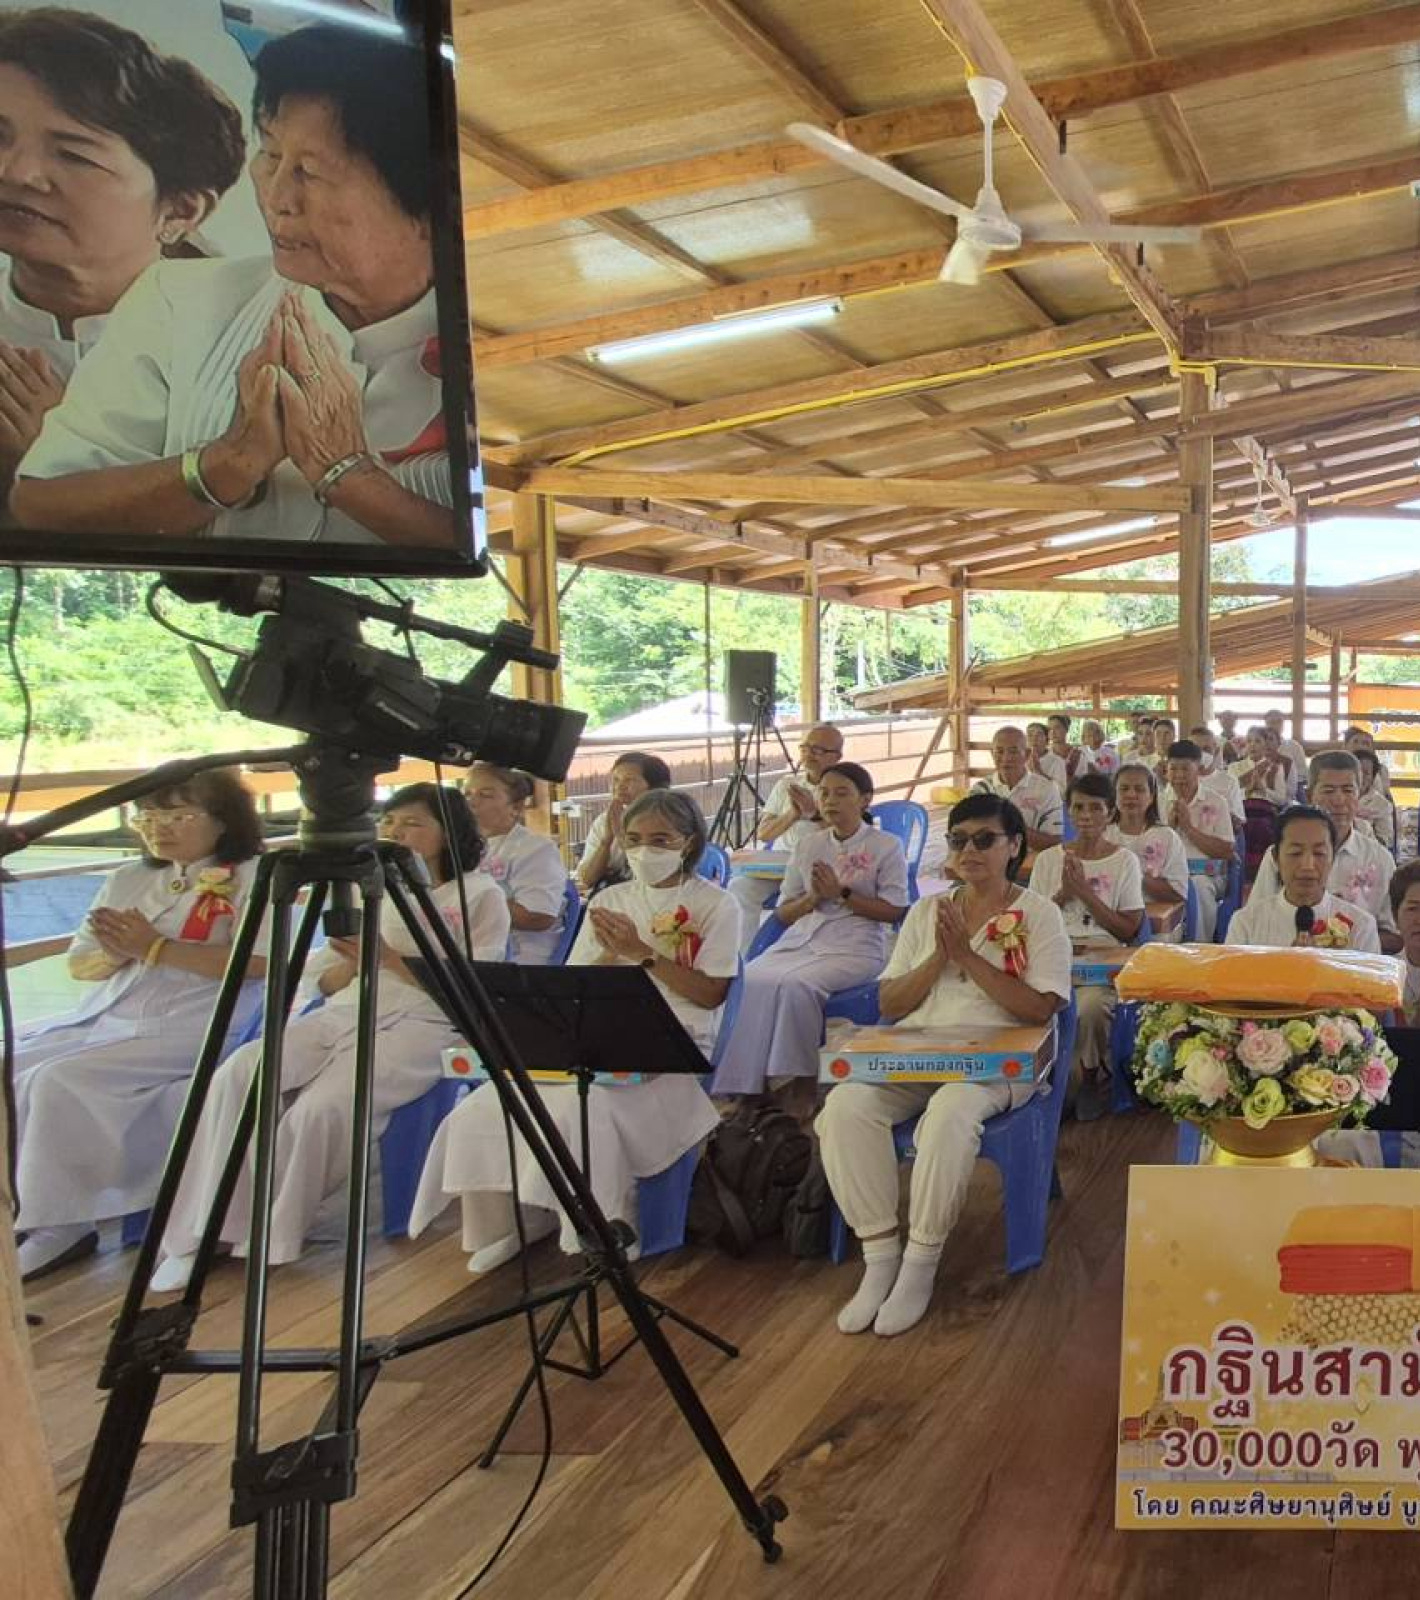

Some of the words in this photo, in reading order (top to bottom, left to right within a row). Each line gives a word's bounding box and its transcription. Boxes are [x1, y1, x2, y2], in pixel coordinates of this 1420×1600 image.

[1164, 1421, 1380, 1475] 30,000วัด
[1133, 1490, 1179, 1516] โดย
[1190, 1490, 1392, 1523] คณะศิษยานุศิษย์
